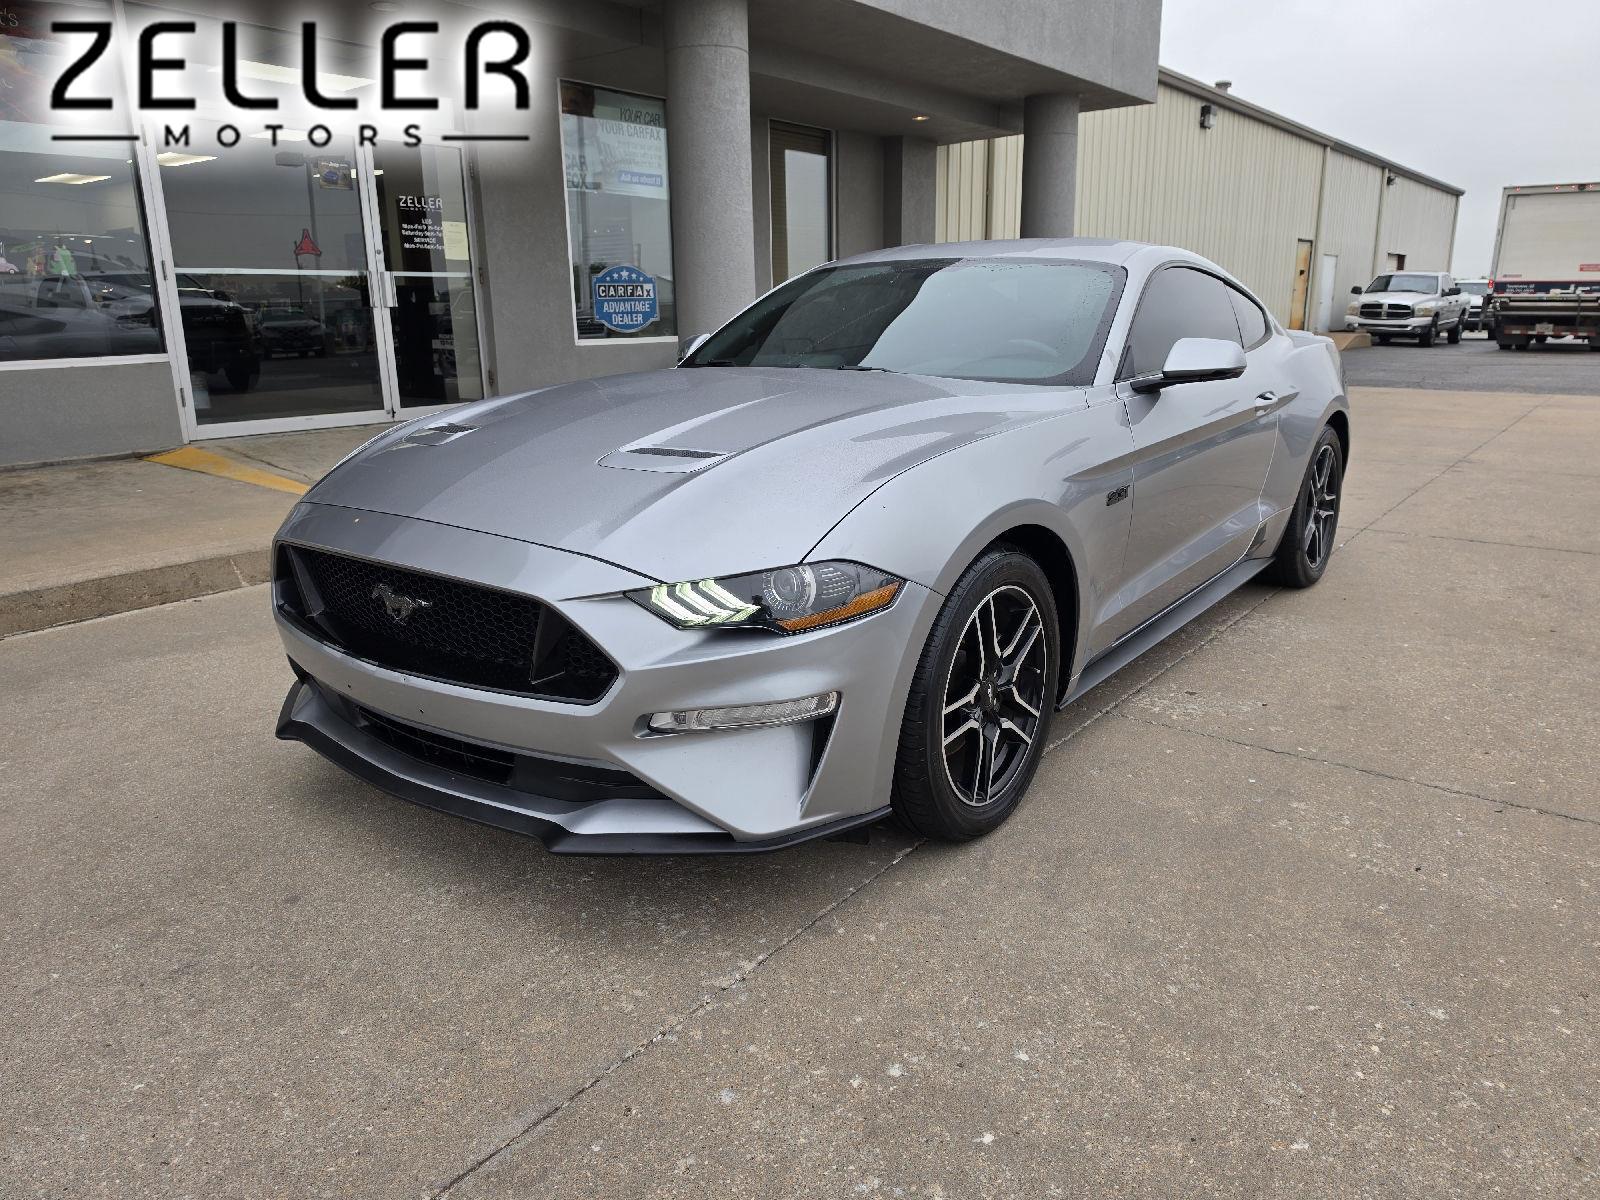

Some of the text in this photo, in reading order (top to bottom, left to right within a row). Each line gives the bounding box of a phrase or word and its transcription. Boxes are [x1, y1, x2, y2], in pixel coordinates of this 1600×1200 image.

[627, 125, 662, 141] CARFAX
[398, 195, 443, 209] ZELLER
[599, 286, 652, 298] CARFAX
[603, 300, 651, 313] ADVANTAGE
[612, 313, 644, 325] DEALER
